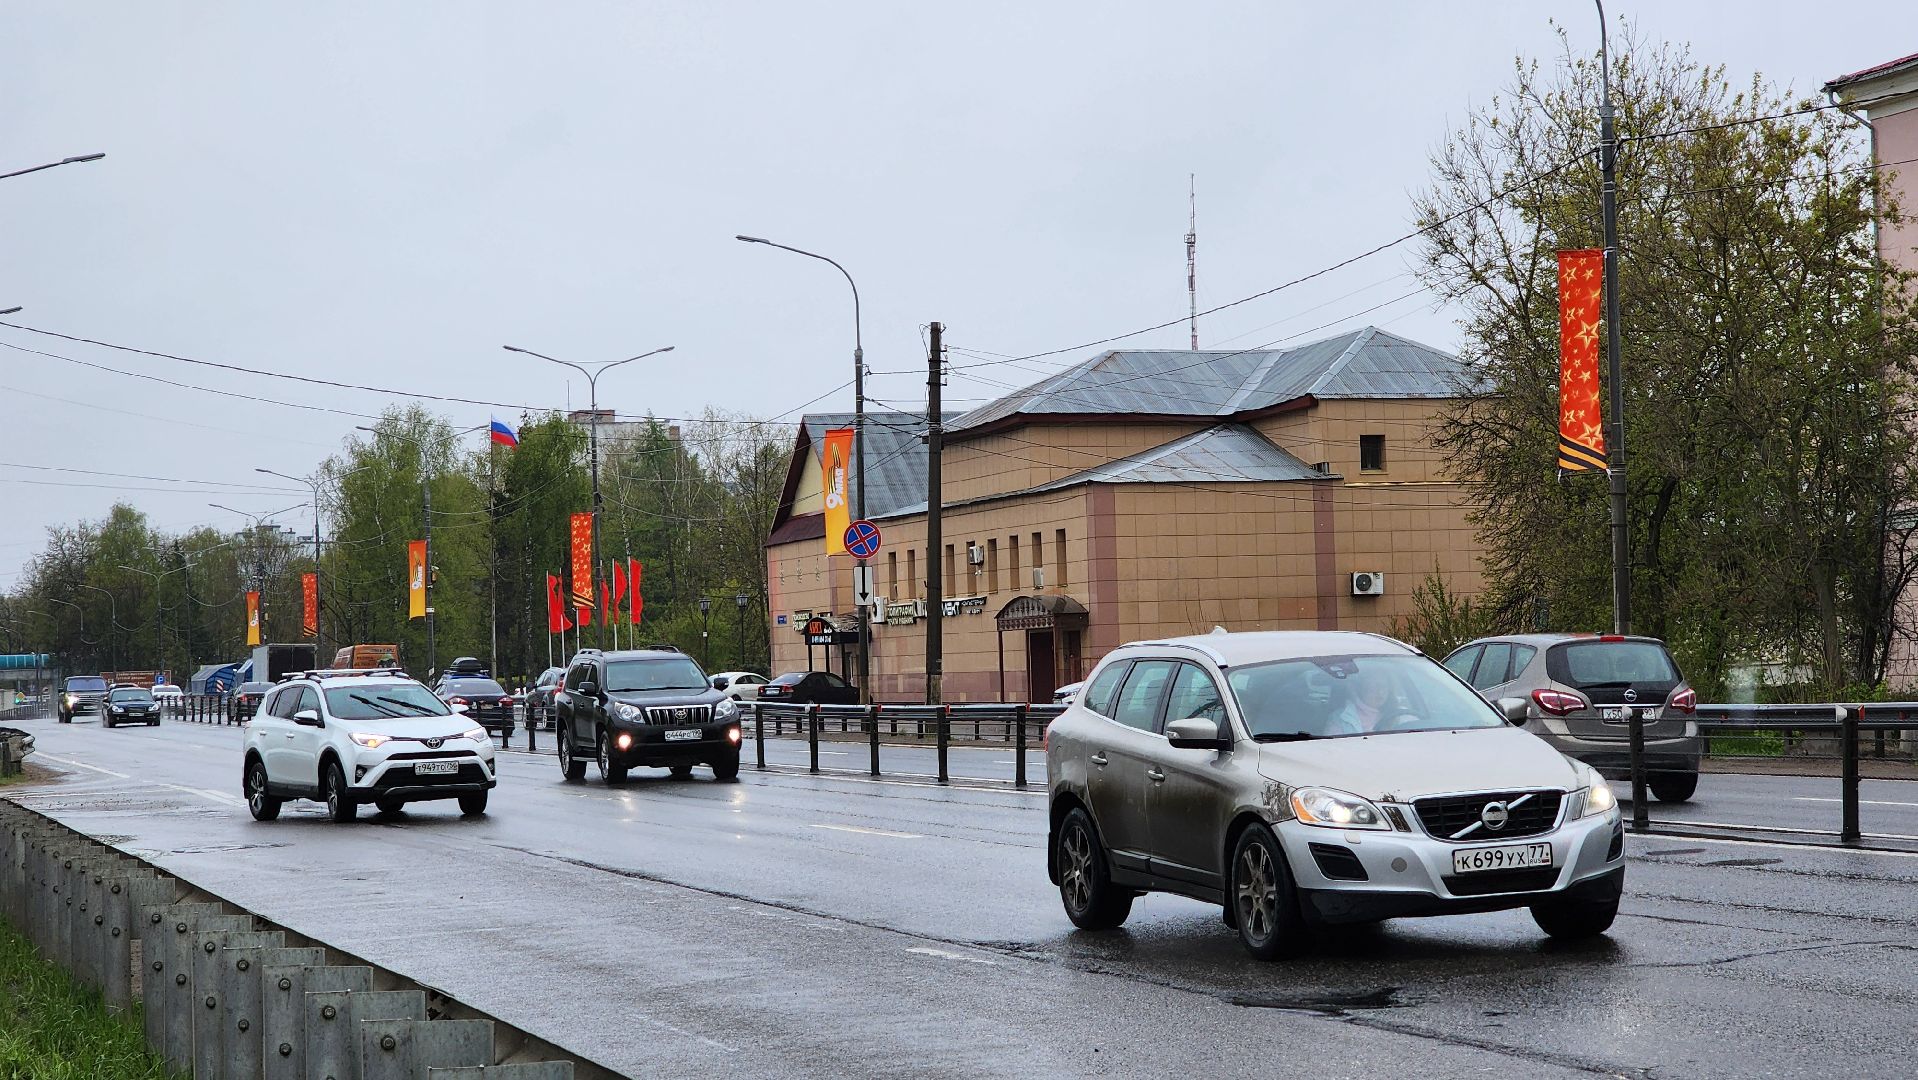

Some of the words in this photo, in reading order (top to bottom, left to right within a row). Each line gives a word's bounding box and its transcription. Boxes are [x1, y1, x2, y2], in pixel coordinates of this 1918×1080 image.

[826, 493, 845, 509] 9
[1461, 850, 1526, 869] К699УХ
[1529, 845, 1544, 858] 77
